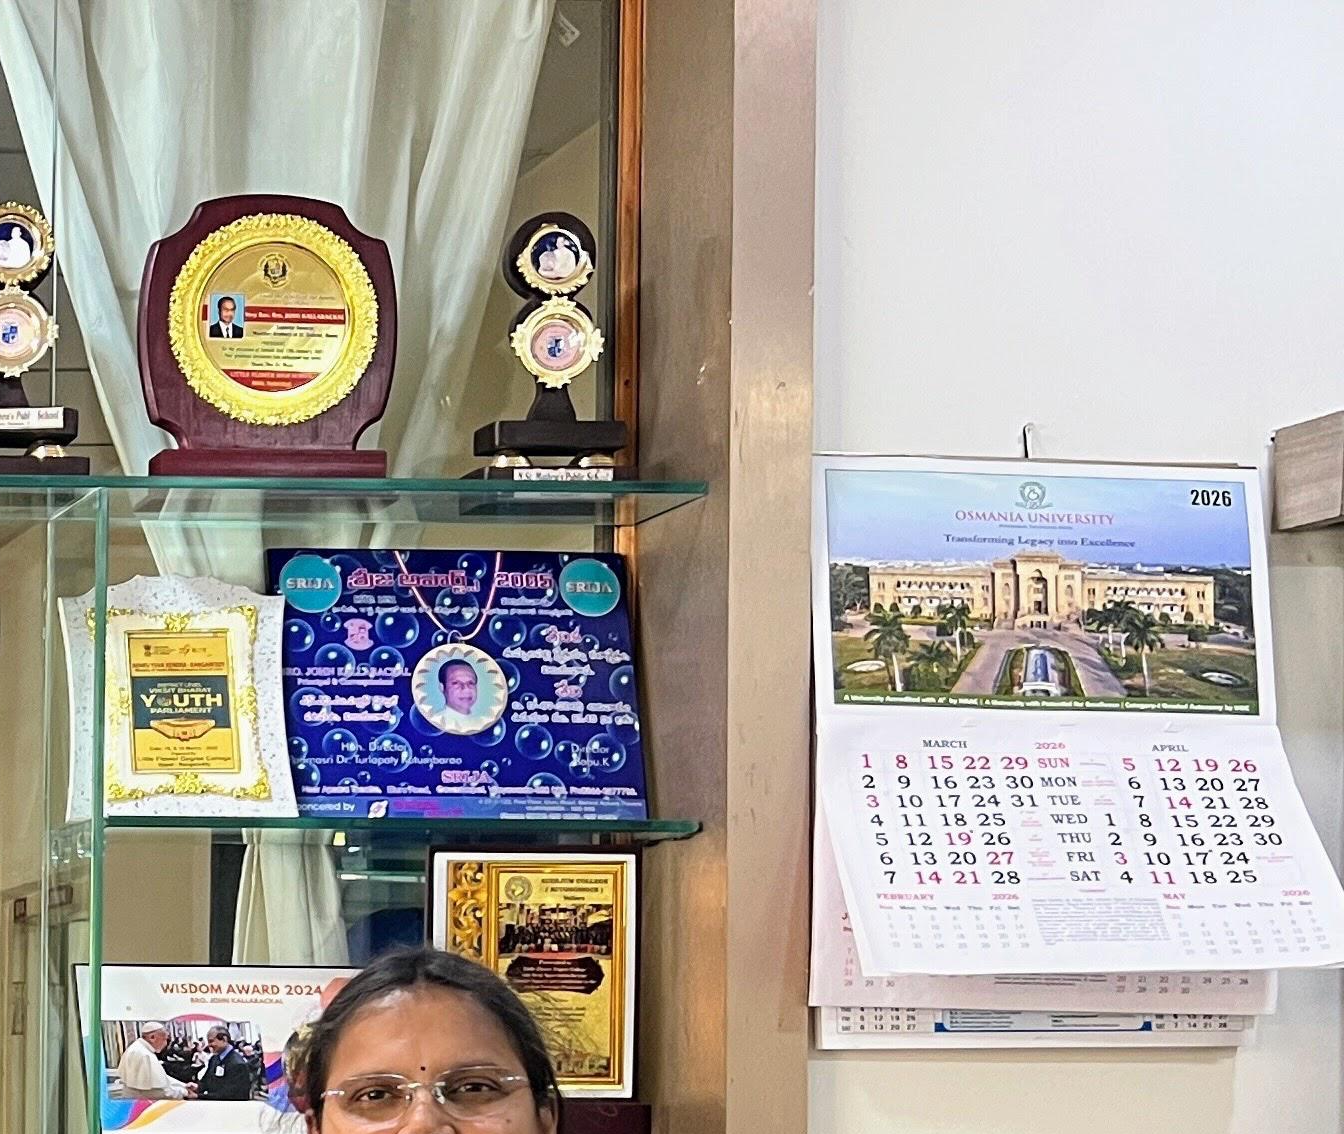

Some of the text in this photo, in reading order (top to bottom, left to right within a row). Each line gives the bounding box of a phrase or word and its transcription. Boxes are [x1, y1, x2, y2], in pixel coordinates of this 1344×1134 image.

[1190, 489, 1233, 508] 2026
[955, 510, 1115, 525] OSMANIA UNIVERSITY
[943, 534, 1136, 548] Transforming Legacy into Excellence
[286, 577, 335, 589] SRIJA
[565, 582, 613, 594] SRIJA
[140, 693, 224, 708] YOUTH
[923, 740, 967, 748] MARCH
[862, 754, 1256, 772] 1 8 15 22 29 SUN 5 12 19 26
[862, 775, 1259, 791] 2 9 16 23 30 MON 6 13 20 27
[343, 802, 355, 812] by
[866, 795, 1268, 809] 3 10 17 24 31 TUE 7 14 21 28
[871, 813, 1274, 827] 4 11 18 25 WED 1 8 15 22 29
[876, 832, 1282, 846] 5 12 19 26 THU 2 9 16 23 30
[880, 852, 1249, 865] 6 13 20 27 FRI 3 10 17 24
[884, 870, 1257, 884] 7 14 21 28 SAT 4 11 18 25
[160, 983, 323, 995] WISDOM AWARD 2024
